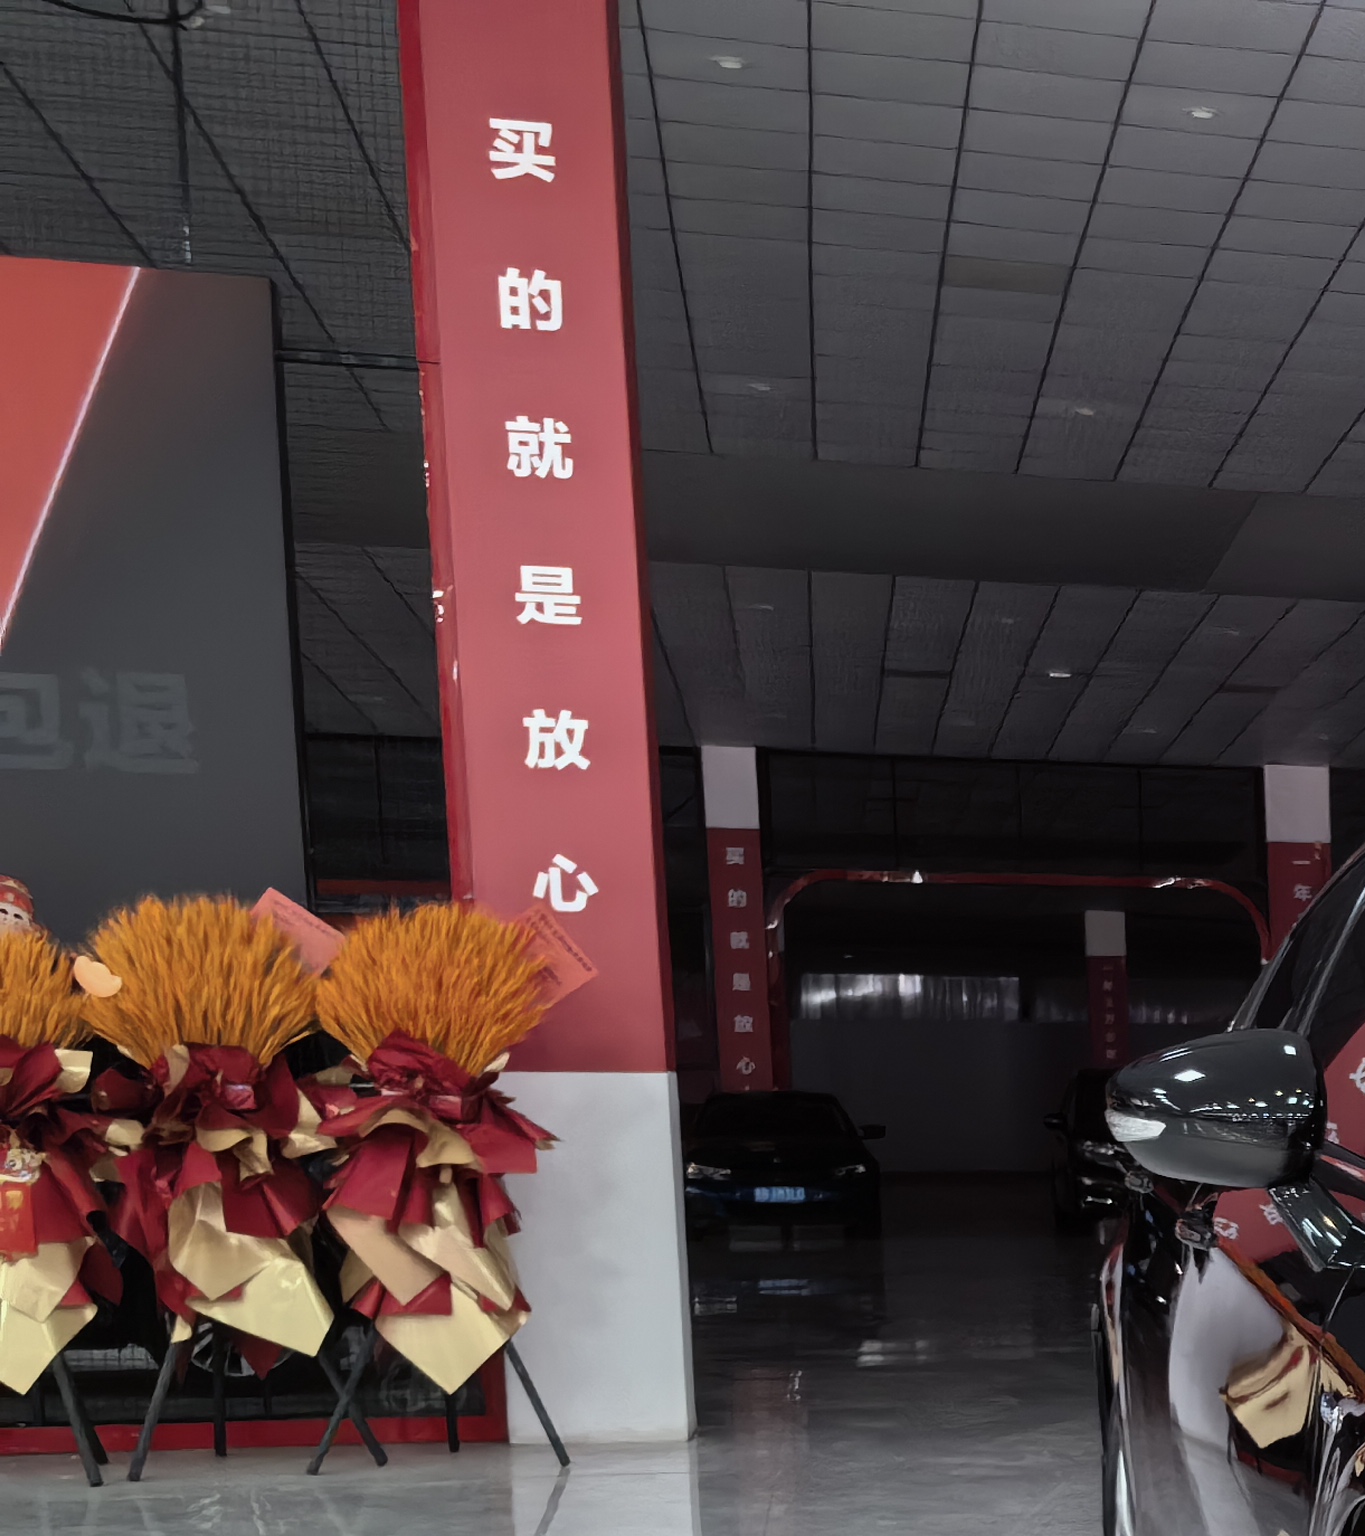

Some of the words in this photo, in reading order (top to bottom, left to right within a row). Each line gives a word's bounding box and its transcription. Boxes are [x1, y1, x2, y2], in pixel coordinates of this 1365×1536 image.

[488, 117, 599, 912] 买的就是放心
